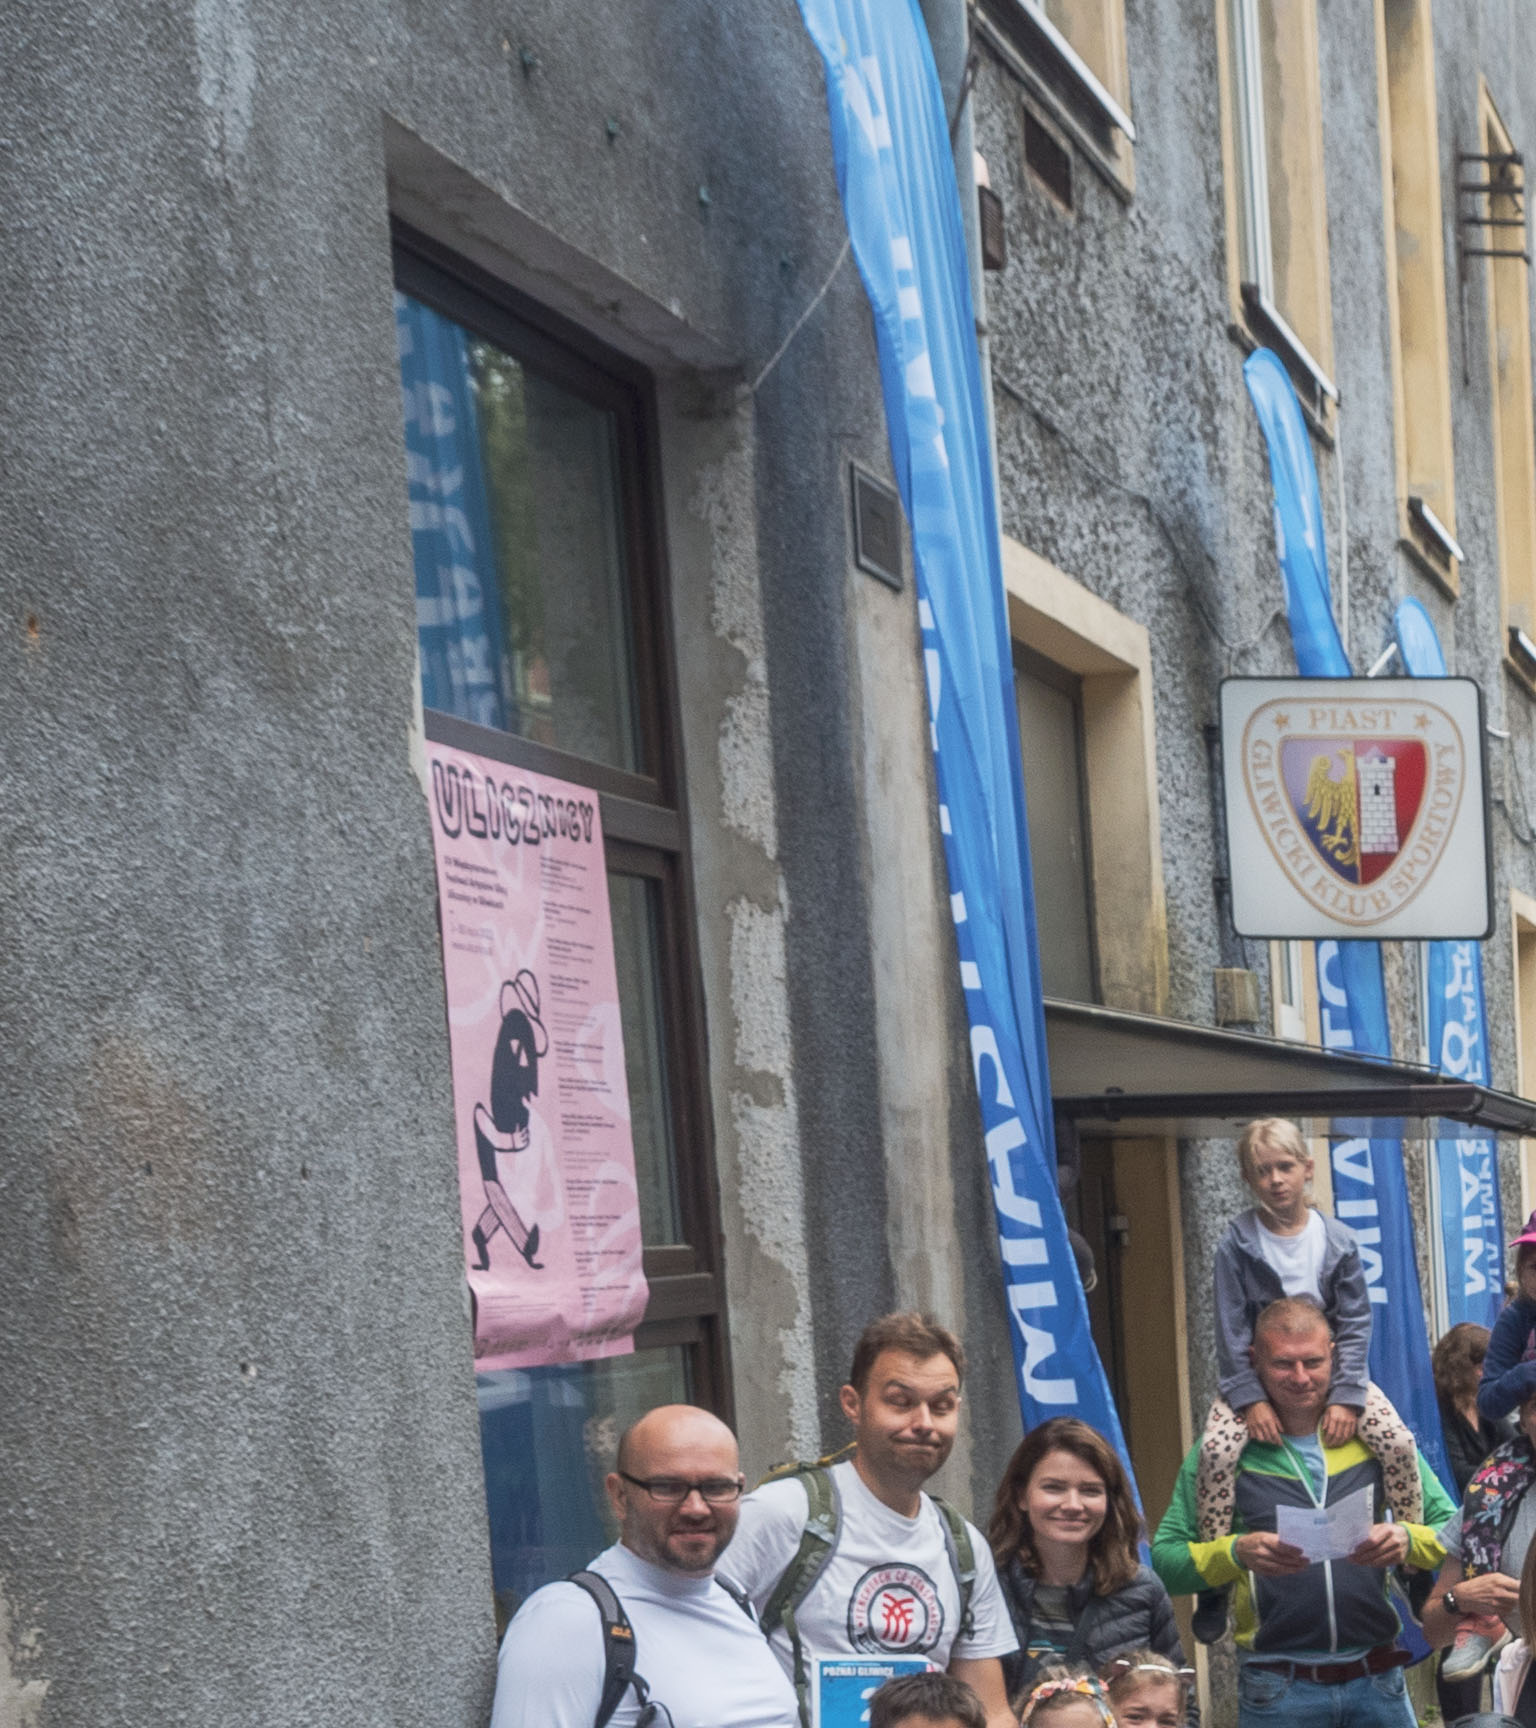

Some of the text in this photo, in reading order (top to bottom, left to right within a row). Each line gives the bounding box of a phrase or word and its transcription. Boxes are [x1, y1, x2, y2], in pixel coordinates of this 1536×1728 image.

[1308, 708, 1396, 730] PIAST
[432, 759, 594, 846] ULICZNICY
[1252, 738, 1457, 917] GLIWICKI KLUB SPORTOWY
